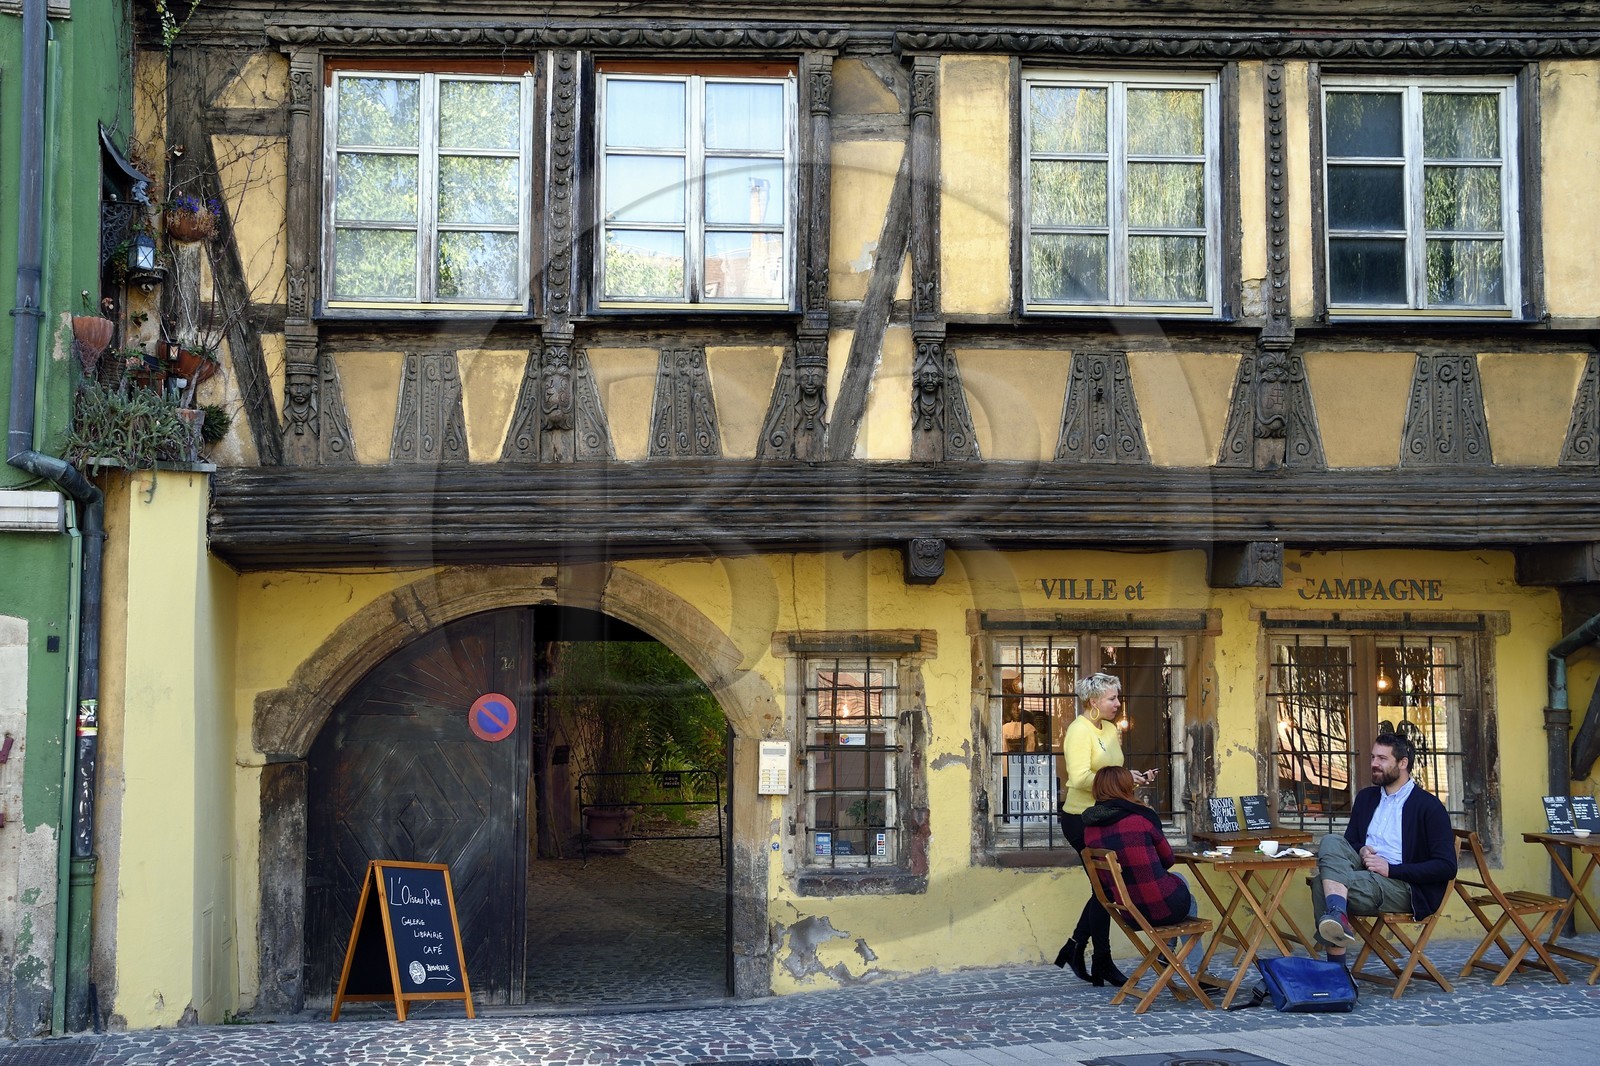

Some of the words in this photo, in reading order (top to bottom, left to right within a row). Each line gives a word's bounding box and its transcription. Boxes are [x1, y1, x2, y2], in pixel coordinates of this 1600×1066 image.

[1040, 578, 1118, 600] VILLE
[1124, 580, 1145, 600] et
[1299, 578, 1444, 600] CAMPAGNE
[423, 943, 442, 955] CAFÉ
